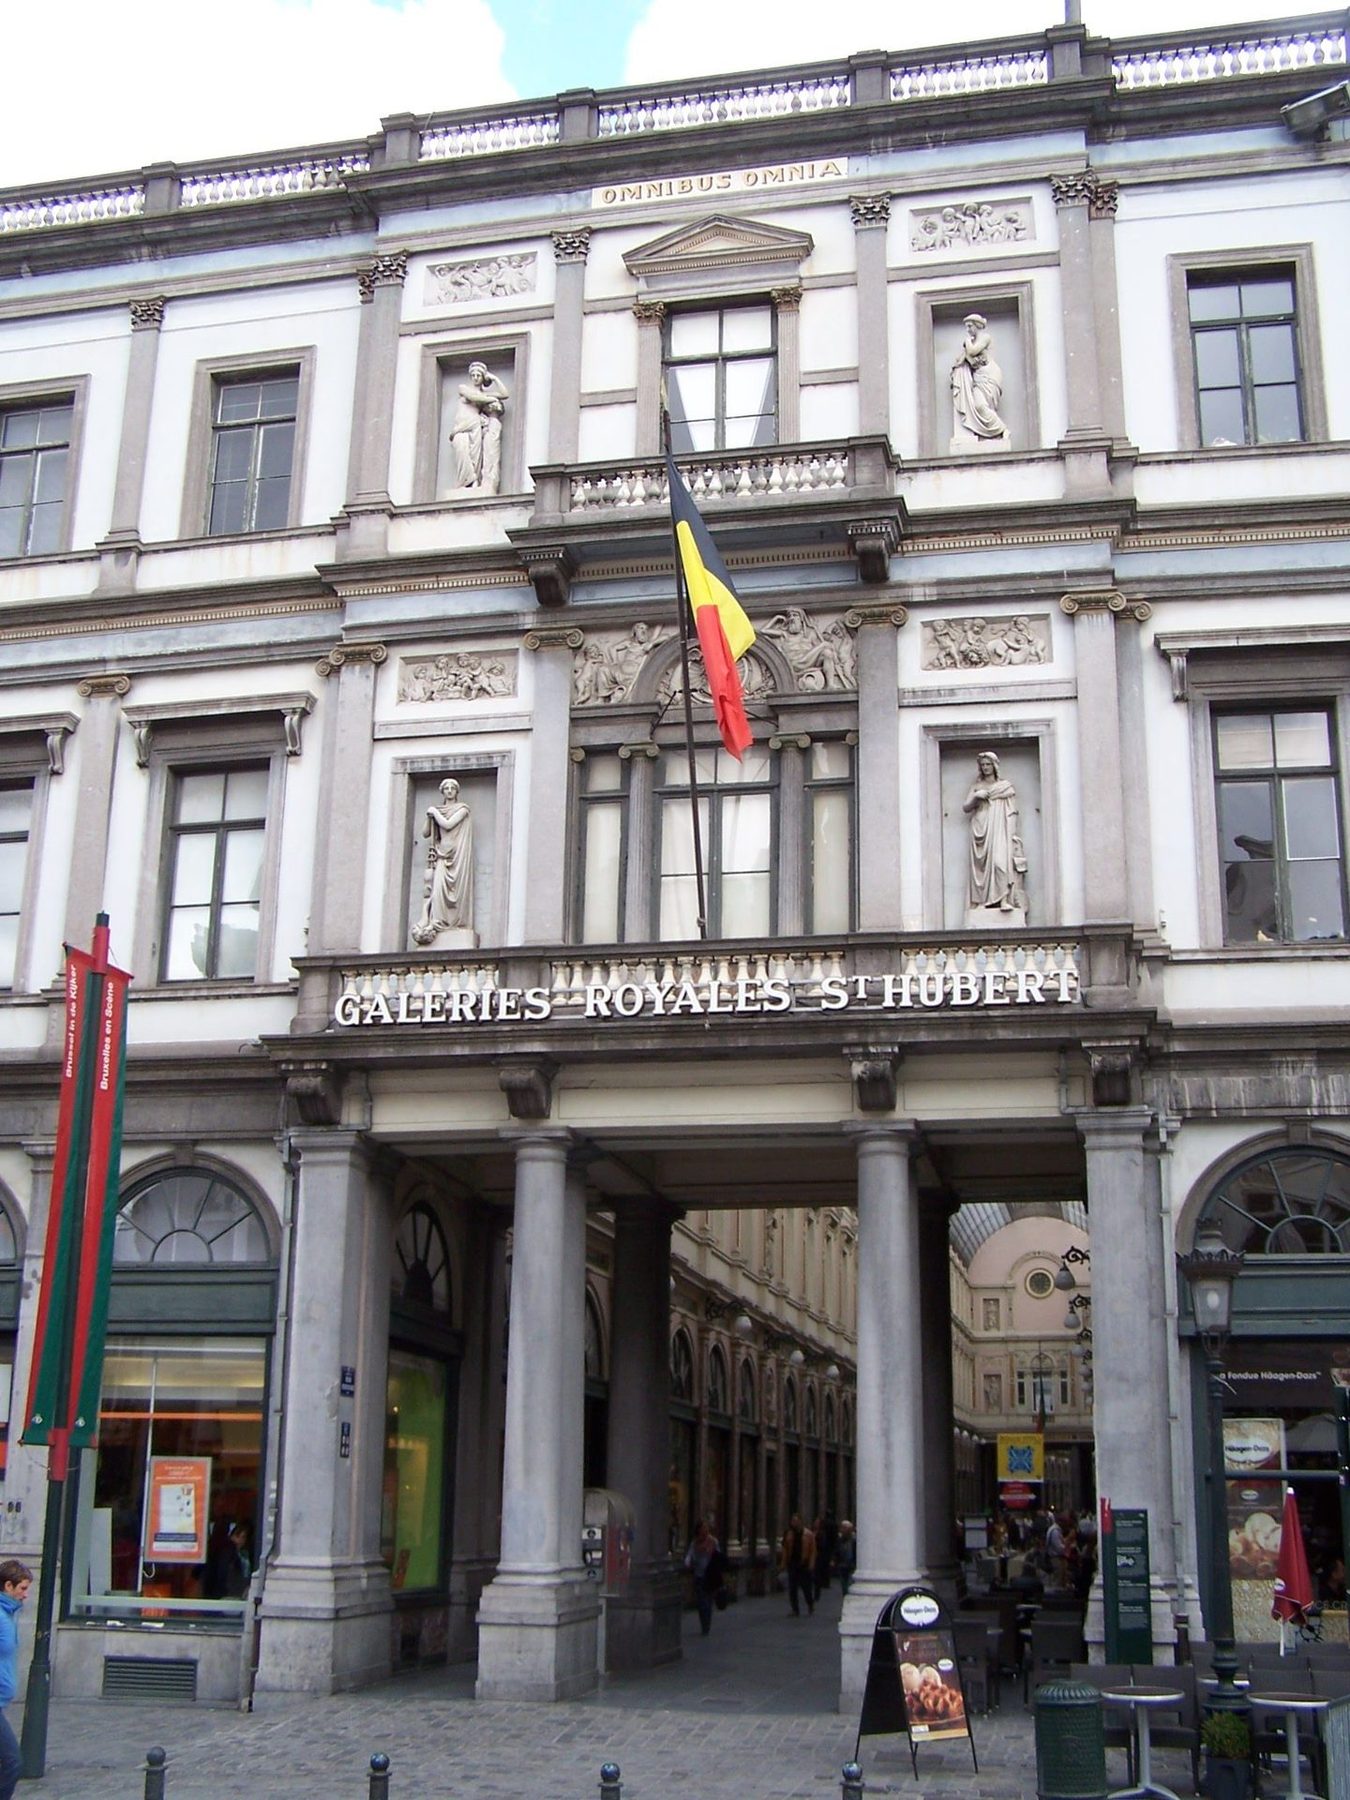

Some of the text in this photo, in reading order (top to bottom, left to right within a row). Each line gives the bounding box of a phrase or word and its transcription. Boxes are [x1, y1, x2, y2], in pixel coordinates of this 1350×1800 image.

[602, 161, 840, 204] OMNIBUS OMNIA
[70, 1001, 77, 1017] de
[334, 987, 551, 1026] GALERIES
[584, 978, 792, 1017] ROYALES
[882, 970, 1079, 1008] HUBERT
[70, 1019, 76, 1032] in
[105, 1019, 112, 1034] en
[65, 1032, 76, 1078] Brussel
[100, 1037, 112, 1090] Bruxelles
